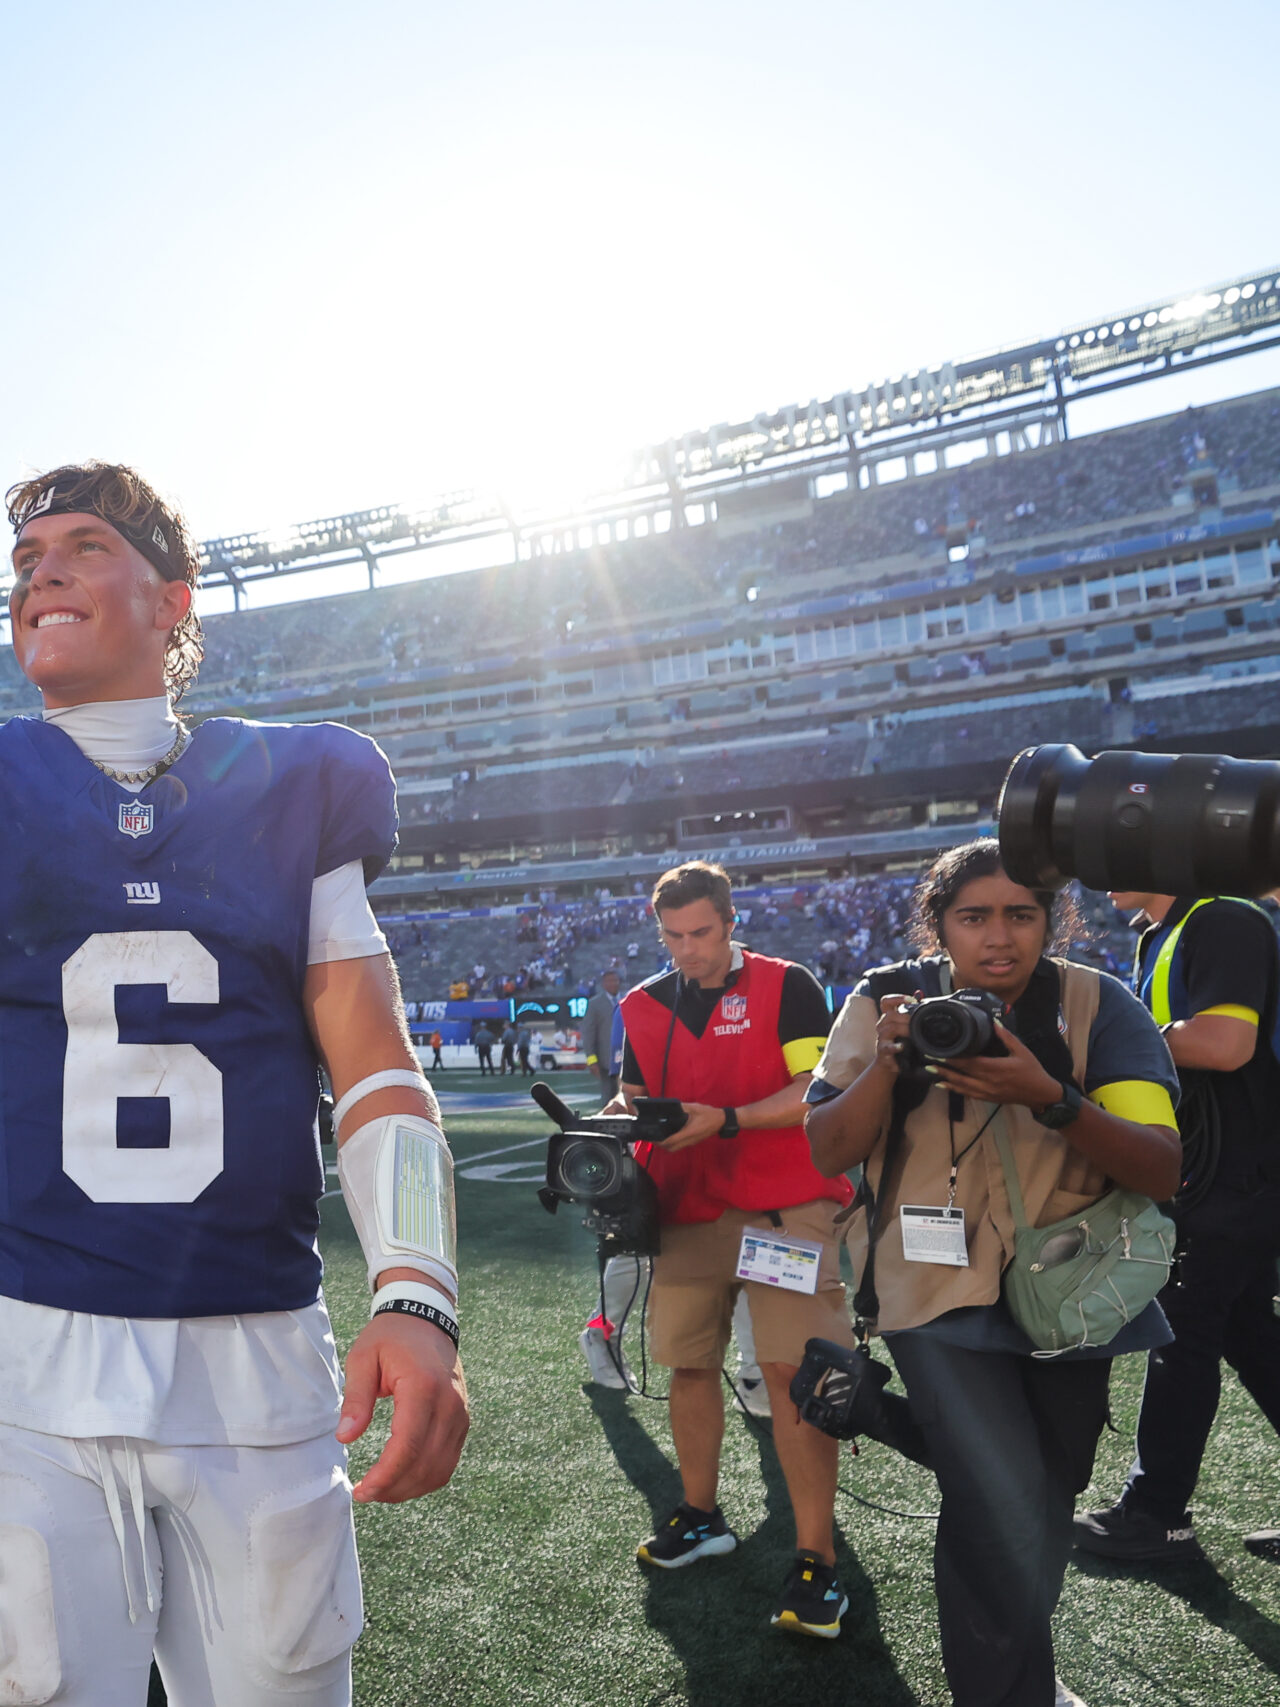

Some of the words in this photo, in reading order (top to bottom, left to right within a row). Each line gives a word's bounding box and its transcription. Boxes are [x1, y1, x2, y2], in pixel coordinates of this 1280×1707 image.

[749, 363, 960, 453] STADIUM
[1129, 783, 1147, 793] G
[124, 816, 147, 830] NFL
[122, 882, 161, 904] ny
[567, 998, 588, 1018] 18
[62, 930, 223, 1203] 6
[401, 1301, 436, 1319] HYPE
